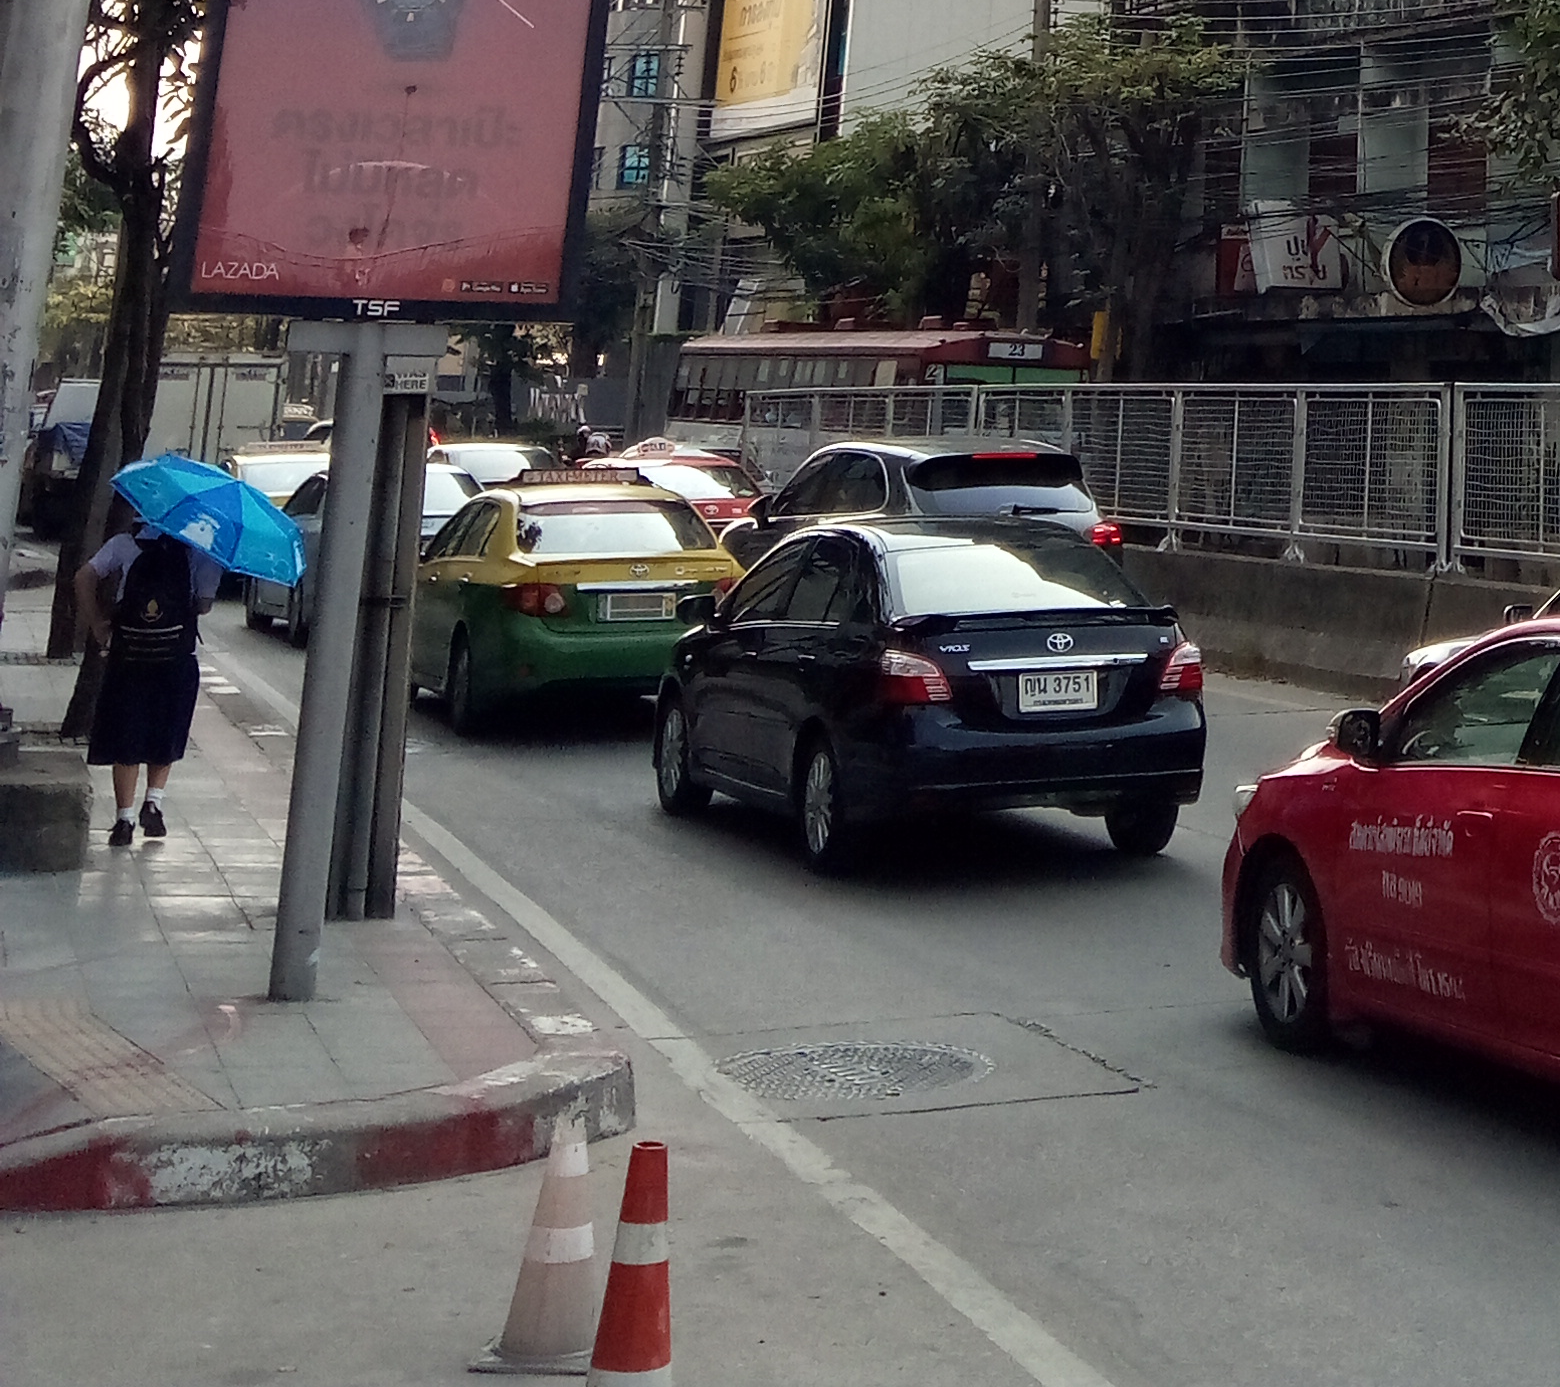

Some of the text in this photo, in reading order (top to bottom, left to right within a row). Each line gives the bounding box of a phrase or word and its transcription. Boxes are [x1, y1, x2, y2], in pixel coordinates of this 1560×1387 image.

[201, 262, 280, 281] LAZADA
[353, 299, 401, 317] TSF
[1008, 344, 1026, 357] 23
[395, 379, 427, 391] HERE
[1053, 674, 1090, 694] 3751
